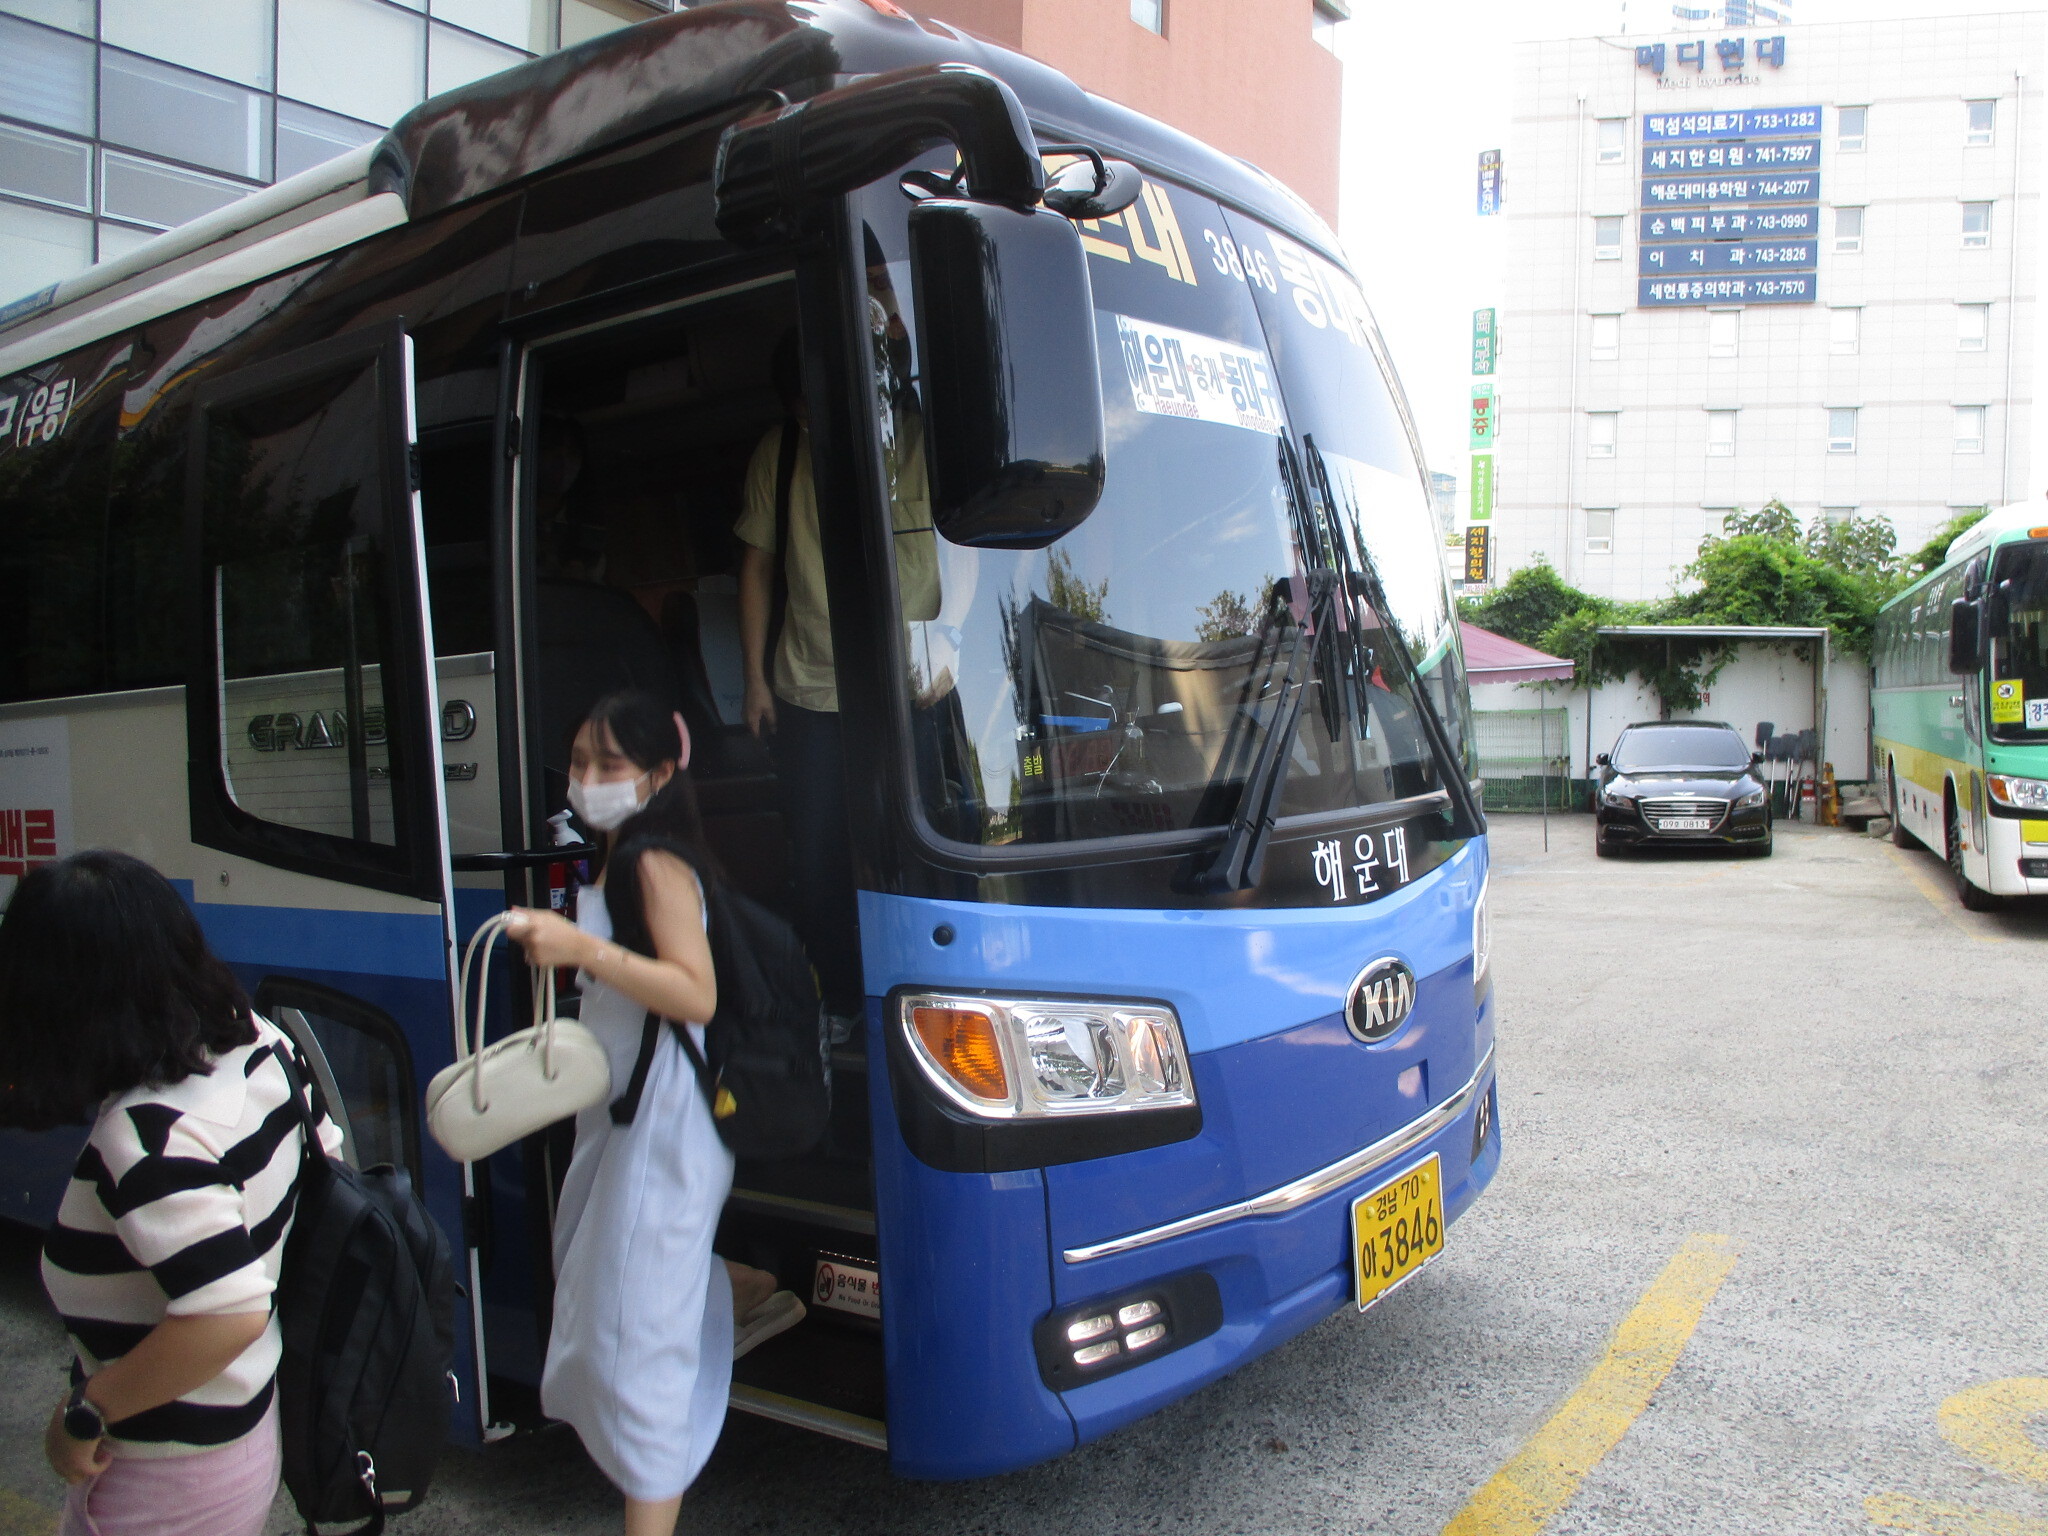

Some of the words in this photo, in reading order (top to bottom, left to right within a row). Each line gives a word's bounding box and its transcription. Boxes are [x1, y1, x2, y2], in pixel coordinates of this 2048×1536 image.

[1636, 36, 1785, 74] 메디현대
[1656, 77, 1690, 89] Medi
[1650, 113, 1744, 136] 맥섬석의료기
[1754, 112, 1815, 128] 753-1282
[1651, 147, 1744, 168] 세지한의원
[1755, 146, 1812, 162] 741-7597
[1651, 181, 1748, 200] 해운대미용학원
[1758, 180, 1810, 195] 744-2077
[1651, 215, 1746, 234] 순백피부과
[1756, 214, 1807, 229] 743-0990
[1203, 228, 1278, 294] 3846
[1755, 247, 1806, 262] 743-2826
[1755, 281, 1805, 295] 743-7570
[1155, 397, 1200, 418] Haeundae
[1468, 527, 1485, 580] 세지한의원
[248, 700, 476, 752] GRANBD
[1683, 820, 1706, 828] 0813
[1311, 826, 1410, 901] 해운대
[1362, 972, 1411, 1029] KIA
[1377, 1190, 1398, 1221] 경남
[1401, 1175, 1420, 1206] 70
[837, 1274, 867, 1293] 음식물
